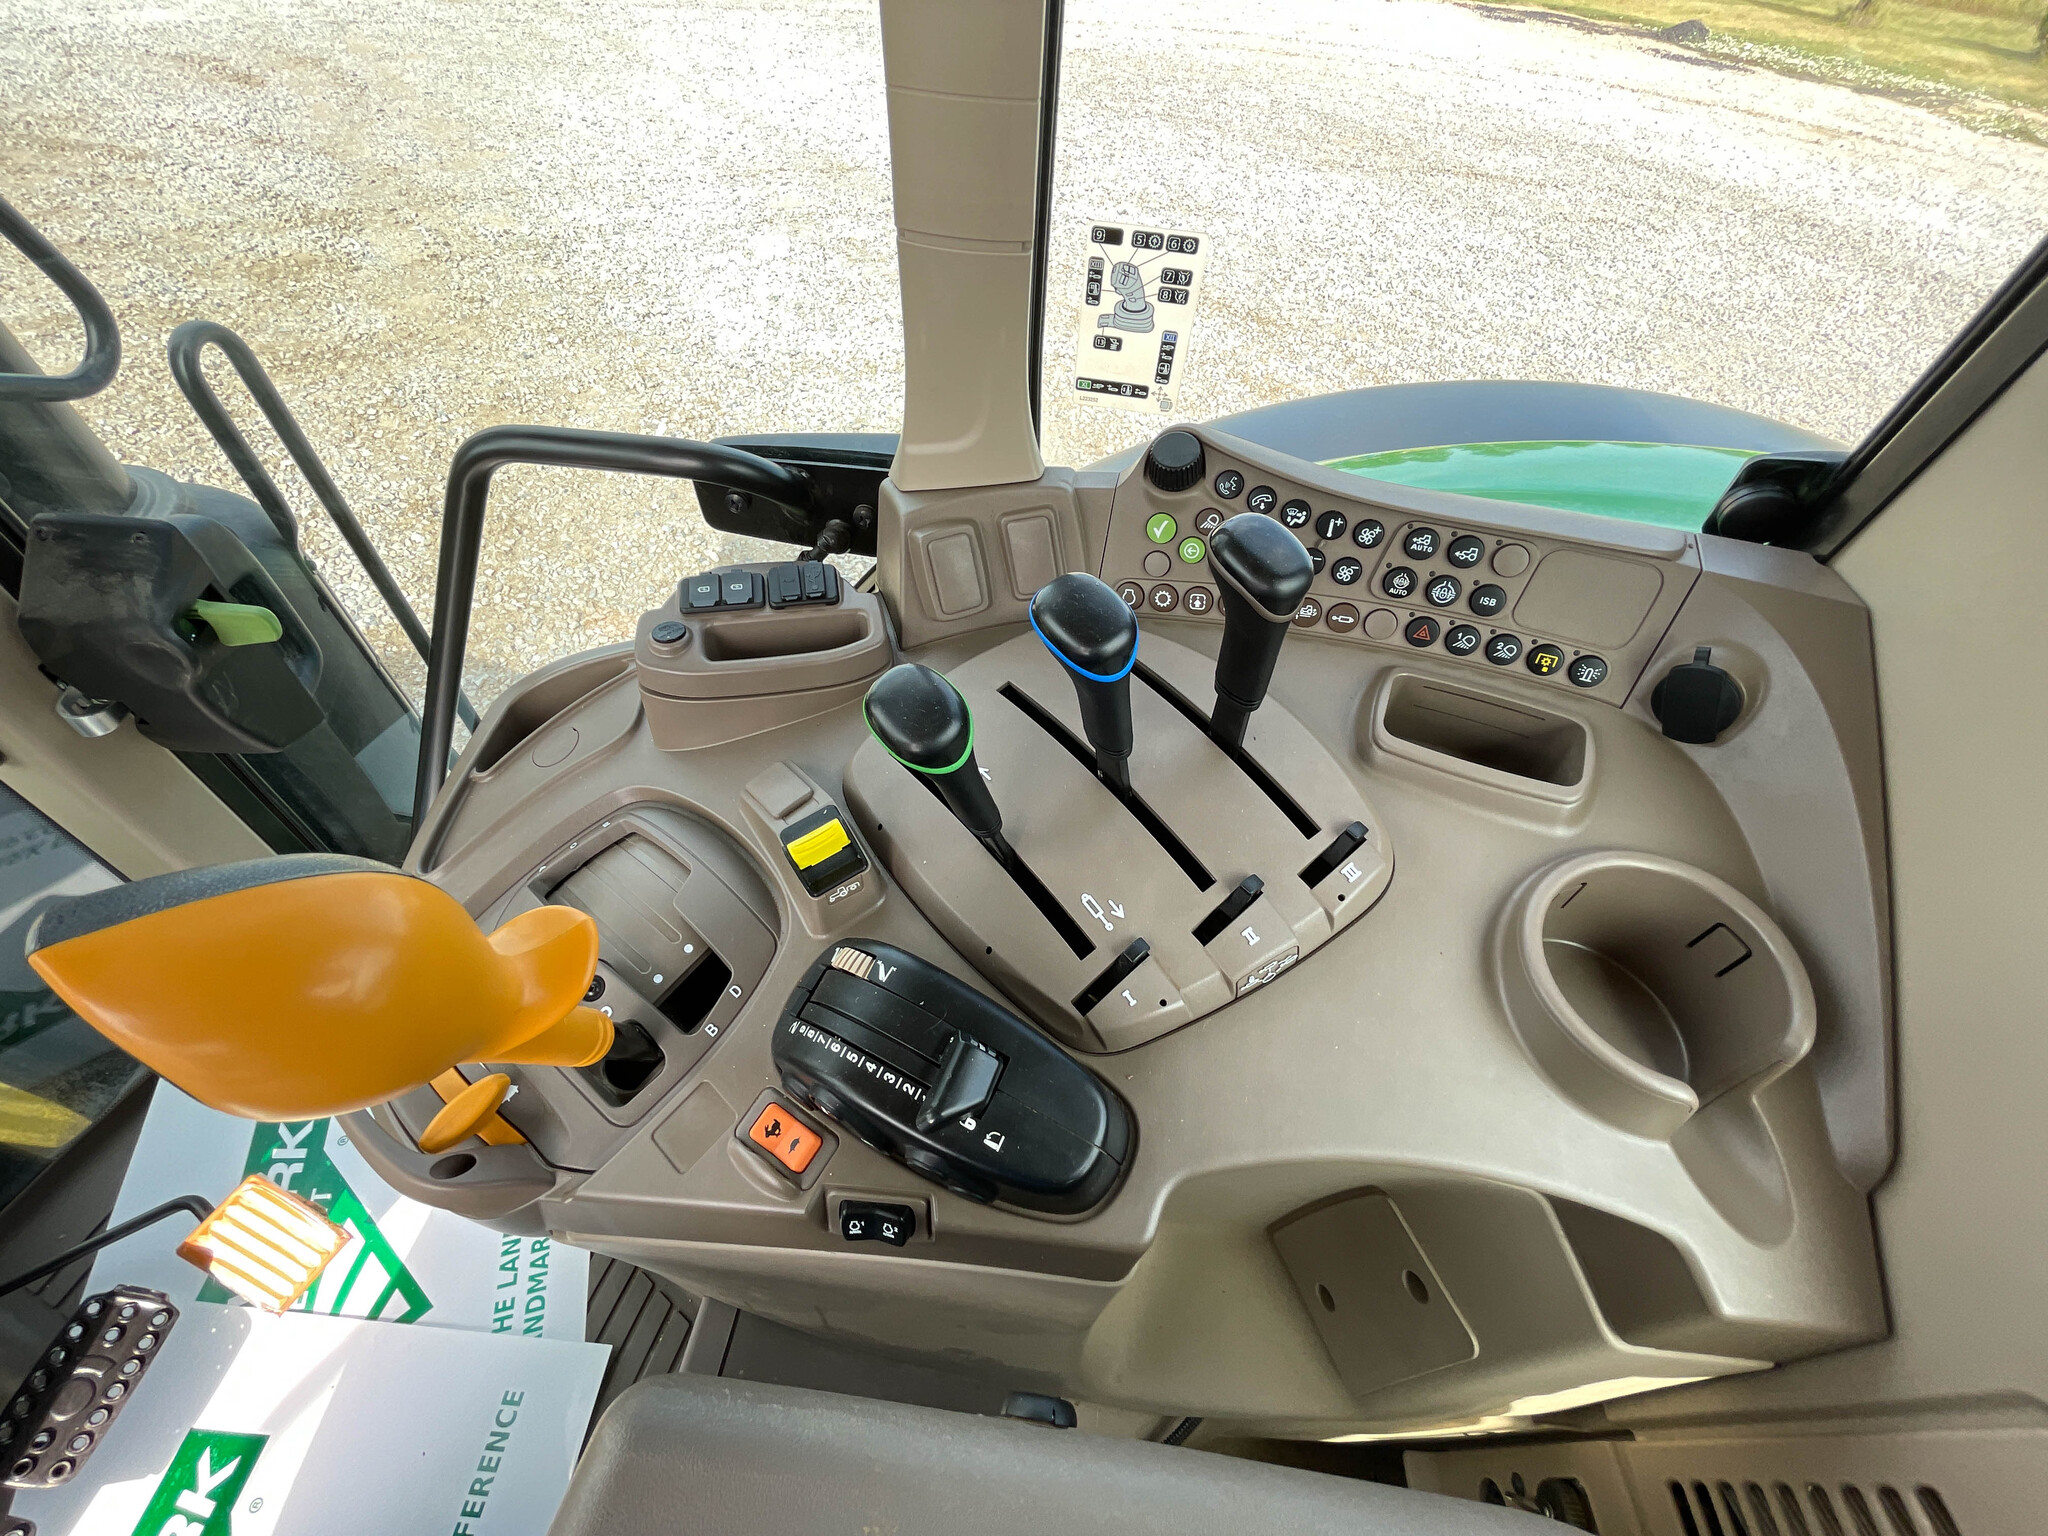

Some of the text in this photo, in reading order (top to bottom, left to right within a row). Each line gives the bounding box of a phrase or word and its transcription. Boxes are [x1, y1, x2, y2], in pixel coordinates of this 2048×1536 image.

[1410, 542, 1433, 553] AUTO
[1388, 587, 1408, 596] AUTO
[1479, 595, 1497, 607] ISB
[1496, 641, 1504, 650] 2
[729, 985, 742, 999] D
[704, 1023, 719, 1037] B
[865, 1061, 878, 1073] 4
[883, 1072, 896, 1084] 3
[902, 1083, 916, 1096] 2
[496, 1233, 522, 1290] LAN
[522, 1237, 551, 1338] NDMAR
